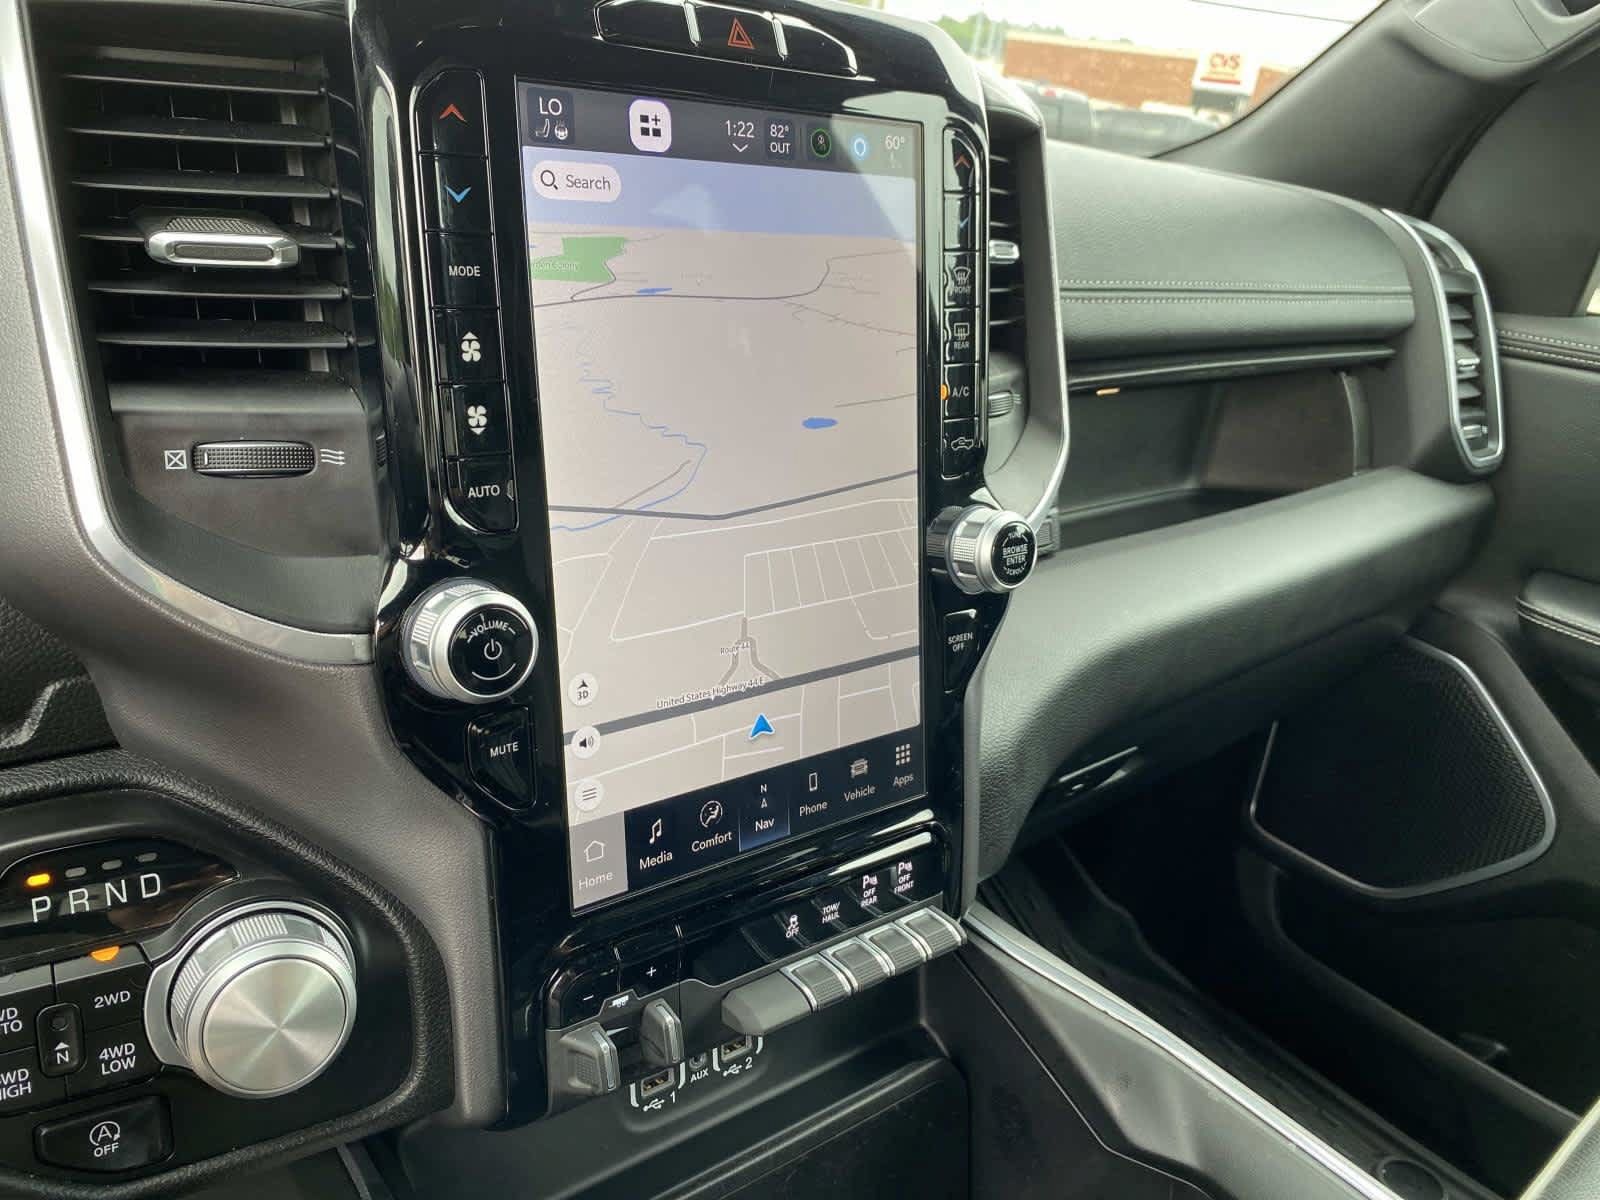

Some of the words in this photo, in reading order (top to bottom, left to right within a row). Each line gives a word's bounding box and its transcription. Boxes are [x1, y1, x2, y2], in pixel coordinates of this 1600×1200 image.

[539, 96, 562, 116] LO
[725, 119, 755, 139] 1:22
[769, 142, 791, 155] OUT
[565, 173, 611, 191] Search
[448, 265, 481, 277] MODE
[953, 341, 970, 350] REAR
[951, 385, 970, 398] A/C
[467, 484, 501, 499] AUTO
[1002, 543, 1029, 556] BROWSE
[1006, 554, 1026, 566] ENTER
[470, 620, 509, 637] VOLUME
[947, 632, 973, 645] SCREEN
[952, 642, 965, 653] OFF
[577, 690, 589, 700] 3D
[655, 696, 685, 709] United
[686, 689, 711, 703] States
[712, 682, 747, 697] Highway
[489, 742, 519, 758] MUTE
[893, 773, 914, 788] Apps
[843, 783, 875, 802] Vehicle
[799, 799, 828, 817] Phone
[754, 817, 775, 832] Nav
[691, 829, 733, 853] Comfort
[638, 850, 674, 871] Media
[578, 870, 613, 890] Home
[898, 873, 911, 884] OFF
[863, 887, 876, 898] OFF
[894, 880, 914, 895] FRONT
[31, 894, 51, 923] P
[68, 887, 90, 915] R
[104, 879, 128, 906] N
[140, 872, 161, 899] D
[860, 895, 878, 908] REAR
[821, 910, 841, 925] HAUL
[785, 926, 800, 939] OFF
[94, 989, 131, 1009] 2WD
[56, 1050, 70, 1064] N
[98, 1042, 136, 1061] 4WD
[101, 1055, 136, 1076] LOW
[744, 1056, 753, 1070] 2
[0, 1068, 29, 1085] WD
[690, 1067, 709, 1083] AUX
[93, 1142, 120, 1158] OFF
